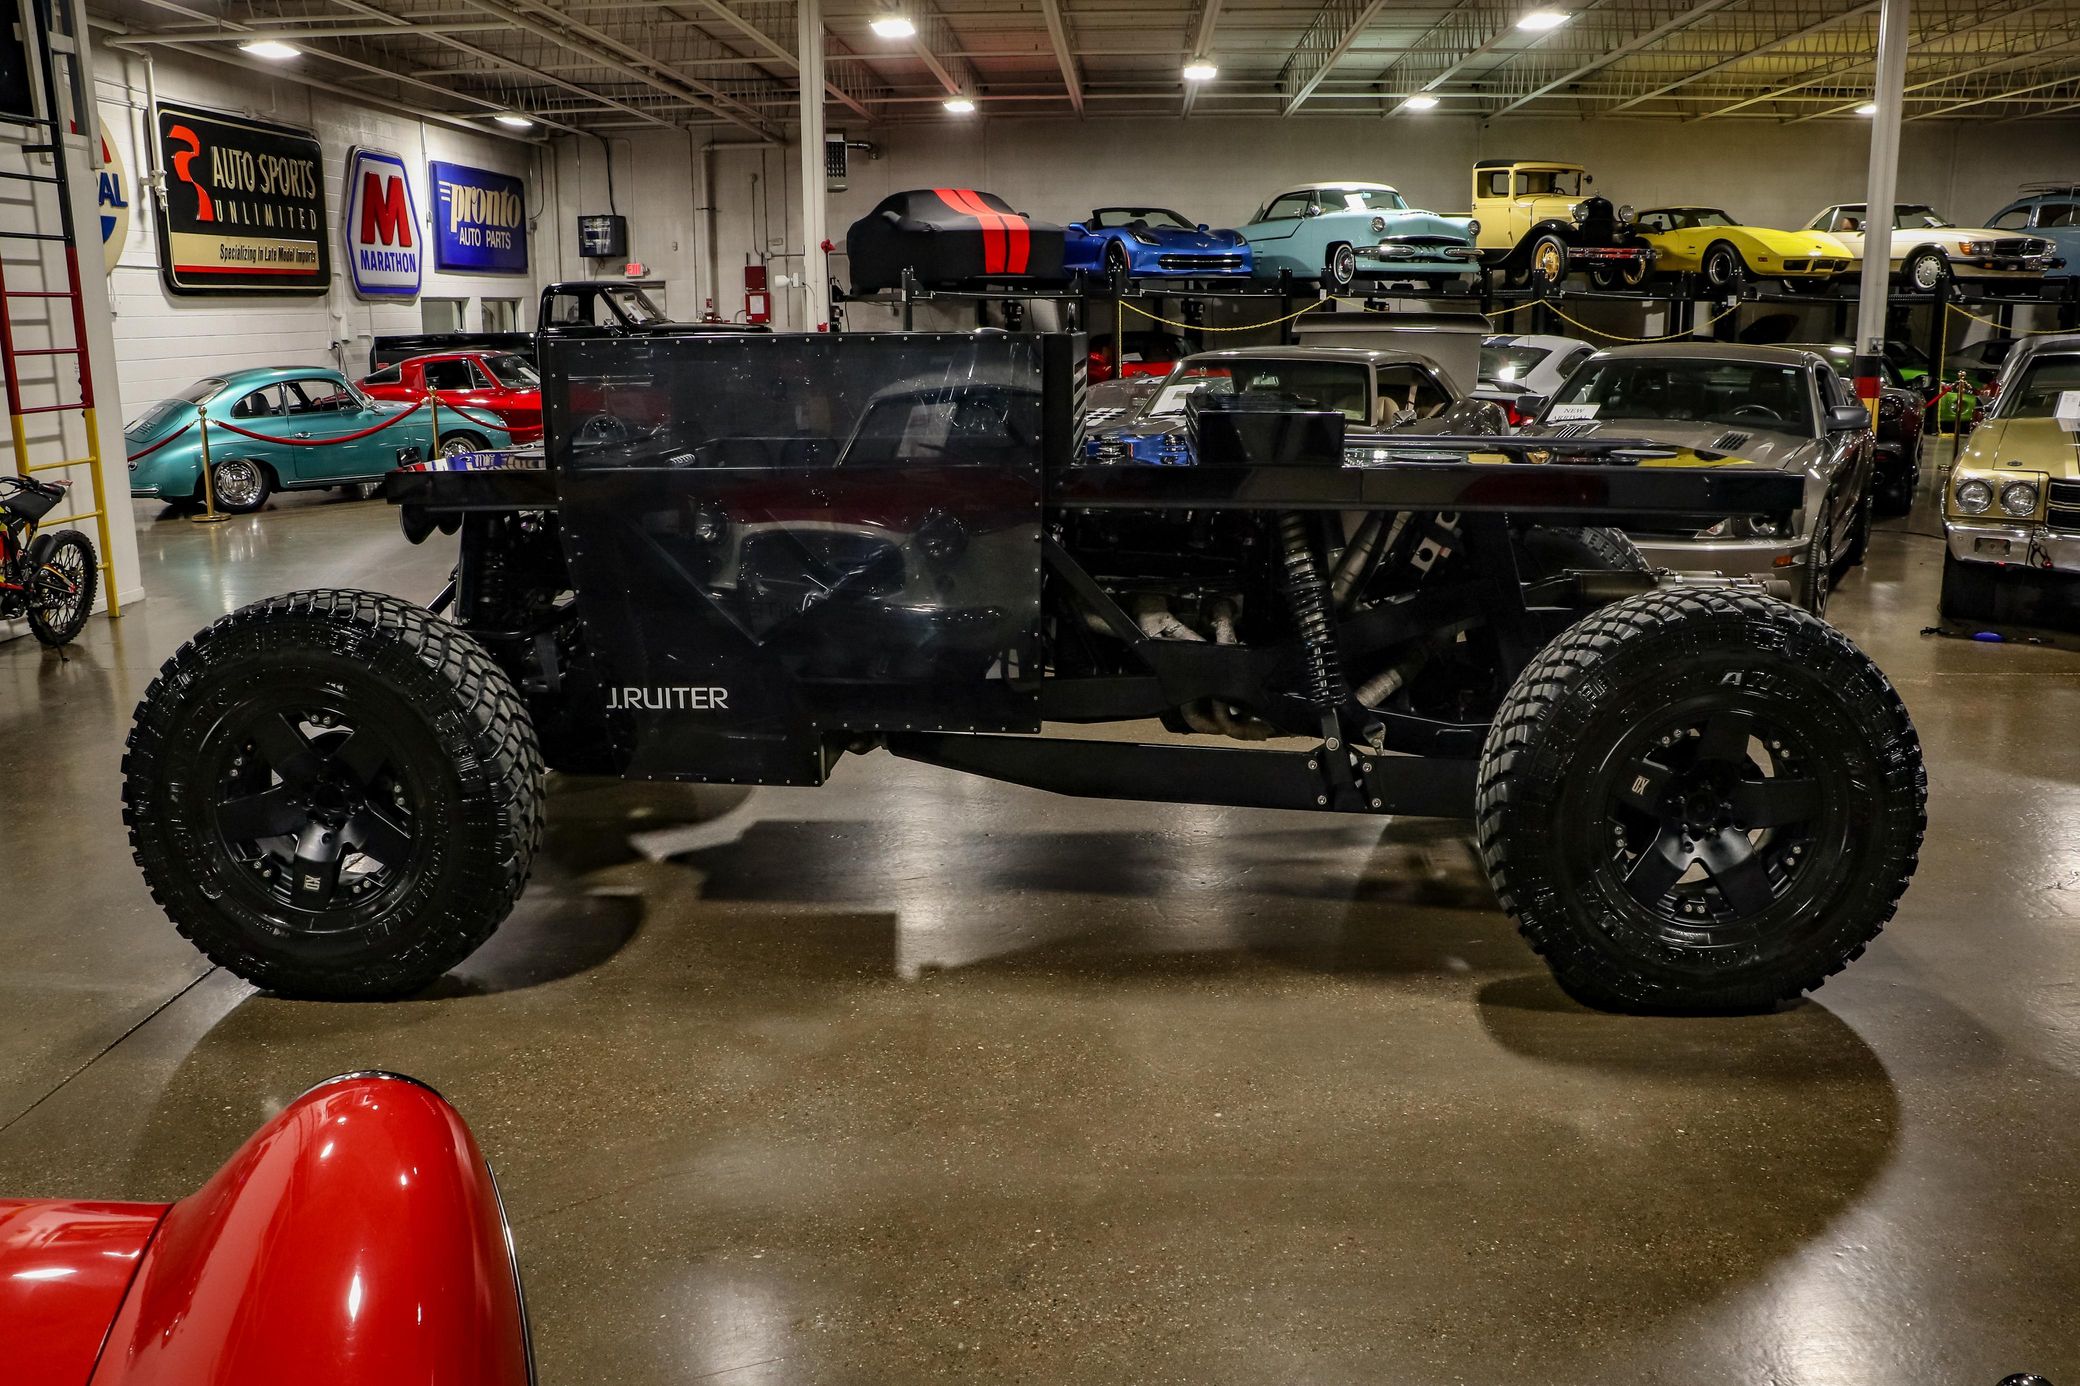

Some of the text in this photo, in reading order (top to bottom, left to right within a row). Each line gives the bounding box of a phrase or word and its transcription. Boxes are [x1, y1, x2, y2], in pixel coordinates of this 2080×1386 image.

[211, 146, 316, 199] AUTO SPORTS
[97, 172, 128, 208] AL
[214, 200, 317, 231] UNLIMITED
[360, 172, 412, 247] M
[450, 182, 522, 233] pronto
[220, 243, 256, 264] Specializing
[265, 247, 277, 262] Late
[278, 247, 294, 262] Model
[460, 227, 511, 250] AUTO PARTS
[360, 250, 416, 272] MARATHON
[606, 687, 729, 709] J.RUITER
